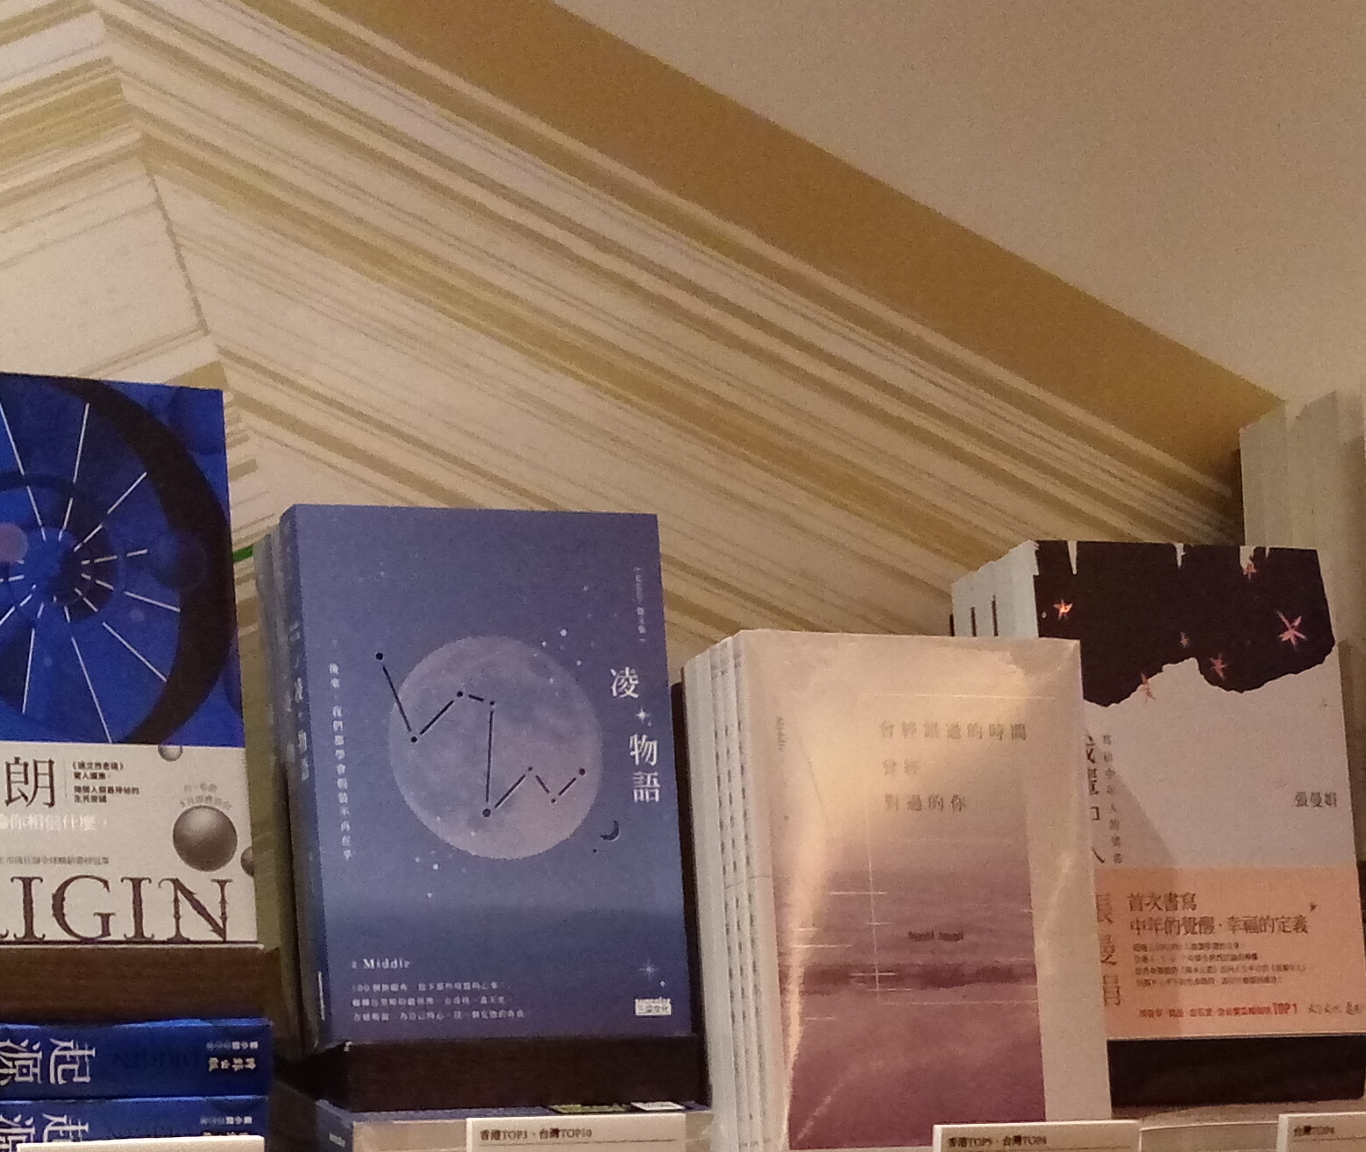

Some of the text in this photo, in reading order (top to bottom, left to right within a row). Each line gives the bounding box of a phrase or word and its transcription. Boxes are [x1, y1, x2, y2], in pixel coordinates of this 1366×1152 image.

[610, 667, 661, 803] 凌物語
[1128, 893, 1197, 912] 首次書寫
